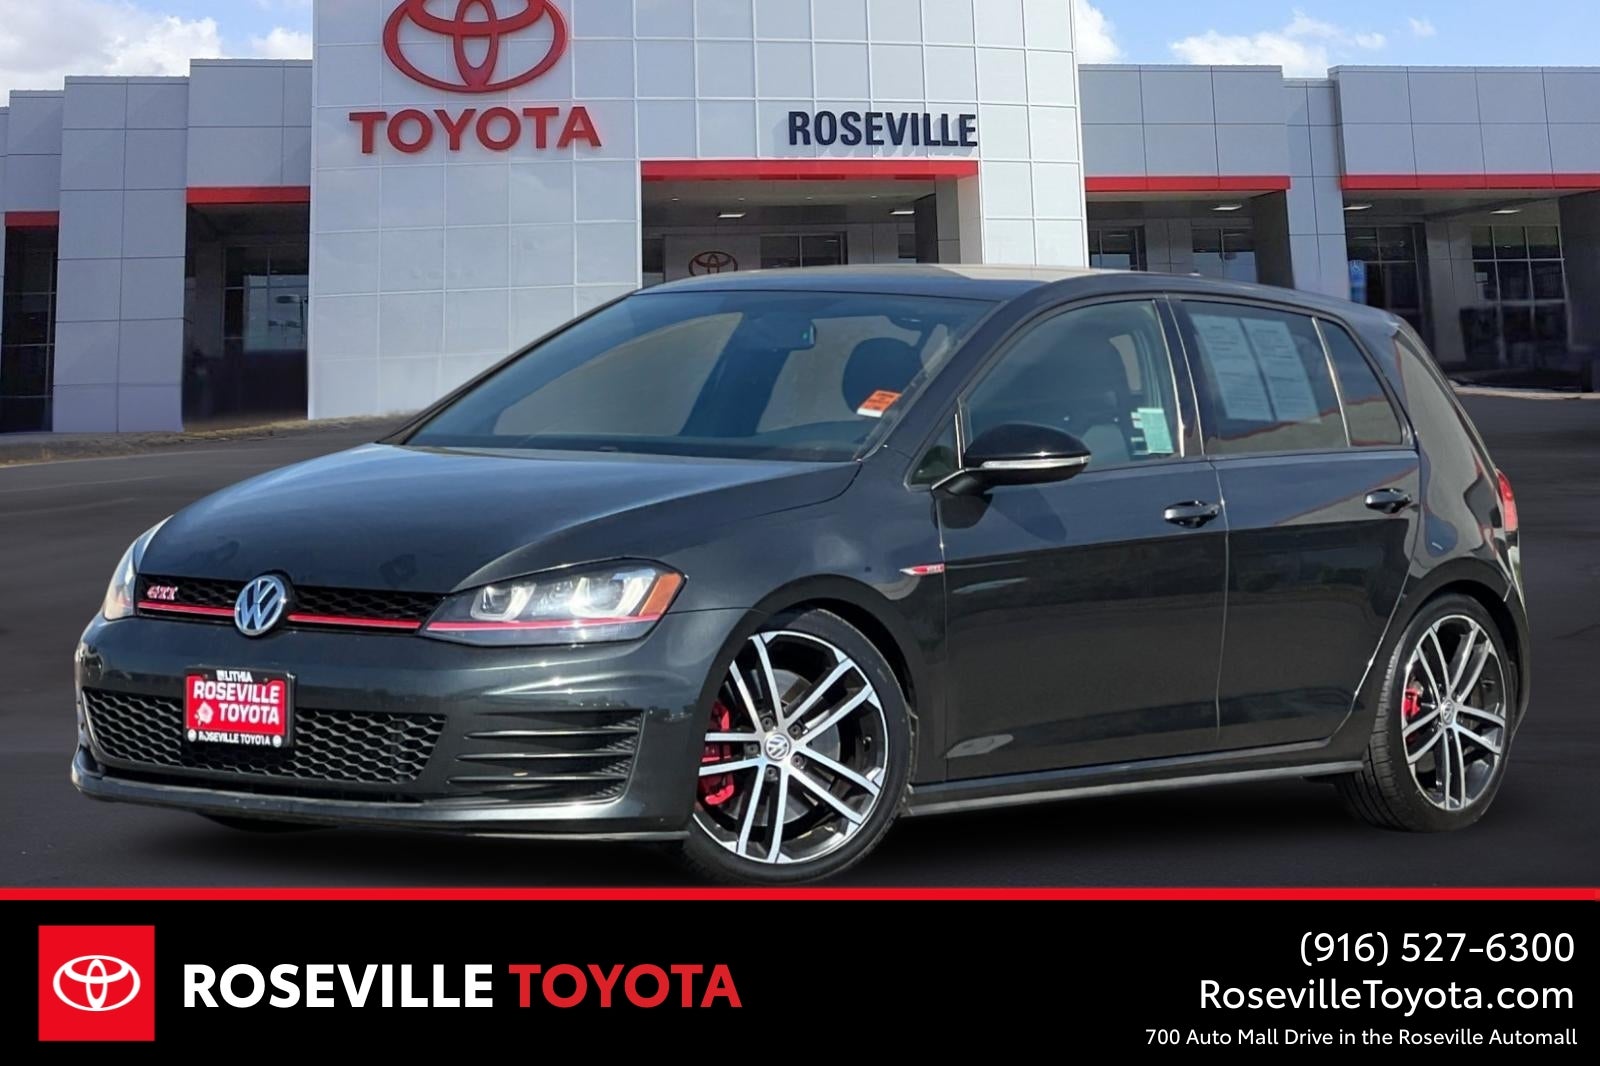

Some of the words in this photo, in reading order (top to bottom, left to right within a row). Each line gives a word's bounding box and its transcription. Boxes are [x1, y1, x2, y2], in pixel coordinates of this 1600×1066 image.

[349, 106, 602, 154] TOYOTA
[788, 110, 978, 148] ROSEVILLE
[224, 670, 253, 682] LITHIA
[193, 680, 280, 704] ROSEVILLE
[218, 703, 280, 725] TOYOTA
[198, 731, 240, 743] ROSEVILLE
[240, 734, 271, 745] TOYOTA
